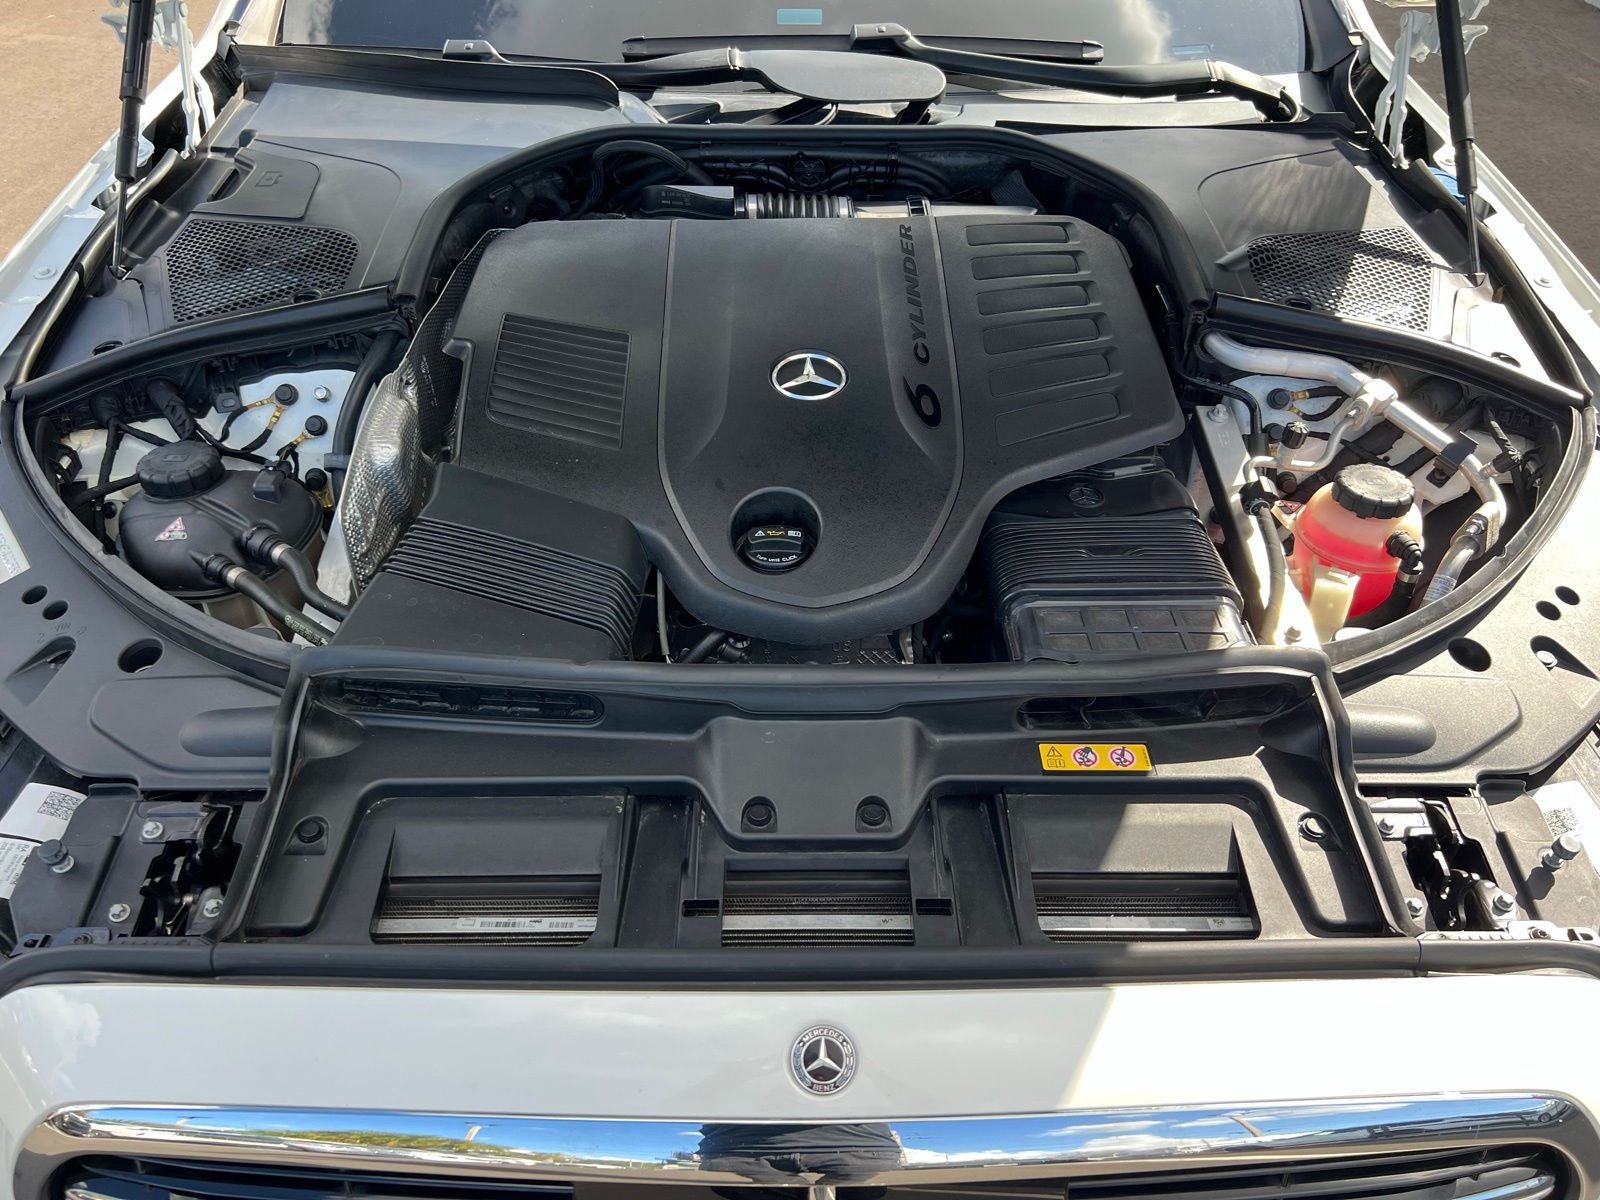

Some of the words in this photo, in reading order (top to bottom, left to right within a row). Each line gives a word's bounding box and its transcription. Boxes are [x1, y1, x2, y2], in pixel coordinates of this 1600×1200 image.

[899, 223, 931, 366] CYLINDER
[902, 376, 942, 428] 6
[802, 1028, 845, 1043] MERCEDES
[812, 1083, 837, 1092] BENZ
